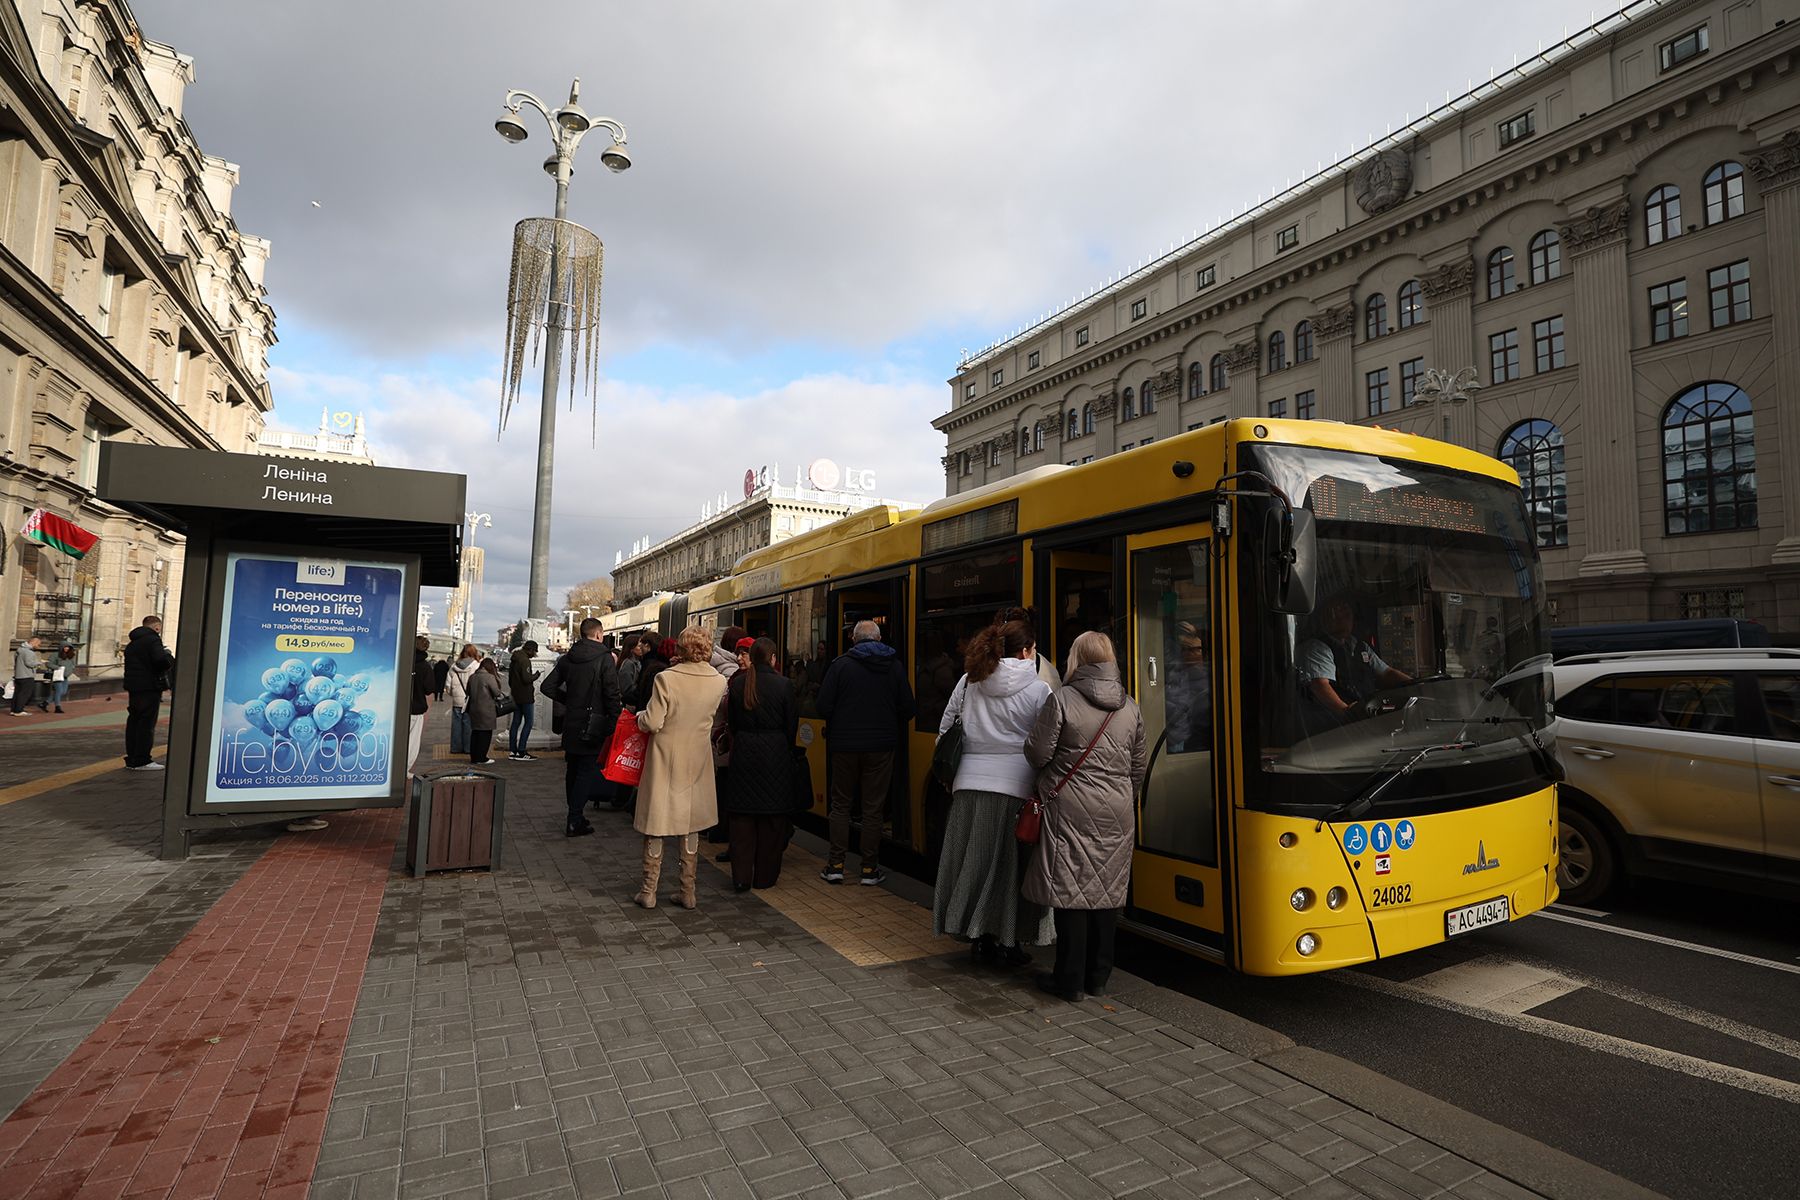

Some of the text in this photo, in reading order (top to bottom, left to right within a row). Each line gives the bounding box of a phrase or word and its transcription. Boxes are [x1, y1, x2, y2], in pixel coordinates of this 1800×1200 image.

[263, 464, 328, 483] Леніна
[845, 466, 876, 491] LG
[261, 485, 333, 505] Ленина
[307, 565, 335, 578] life:)
[275, 588, 362, 603] Переносите
[272, 602, 363, 618] номер в life:)
[273, 623, 302, 631] тарифе
[304, 624, 355, 633] Бесконечный
[285, 638, 345, 648] 14,9 руб/мес
[219, 776, 252, 786] Акция
[264, 775, 318, 784] 18.06.2025
[336, 773, 384, 783] 31.12.2025
[1373, 884, 1411, 907] 24082
